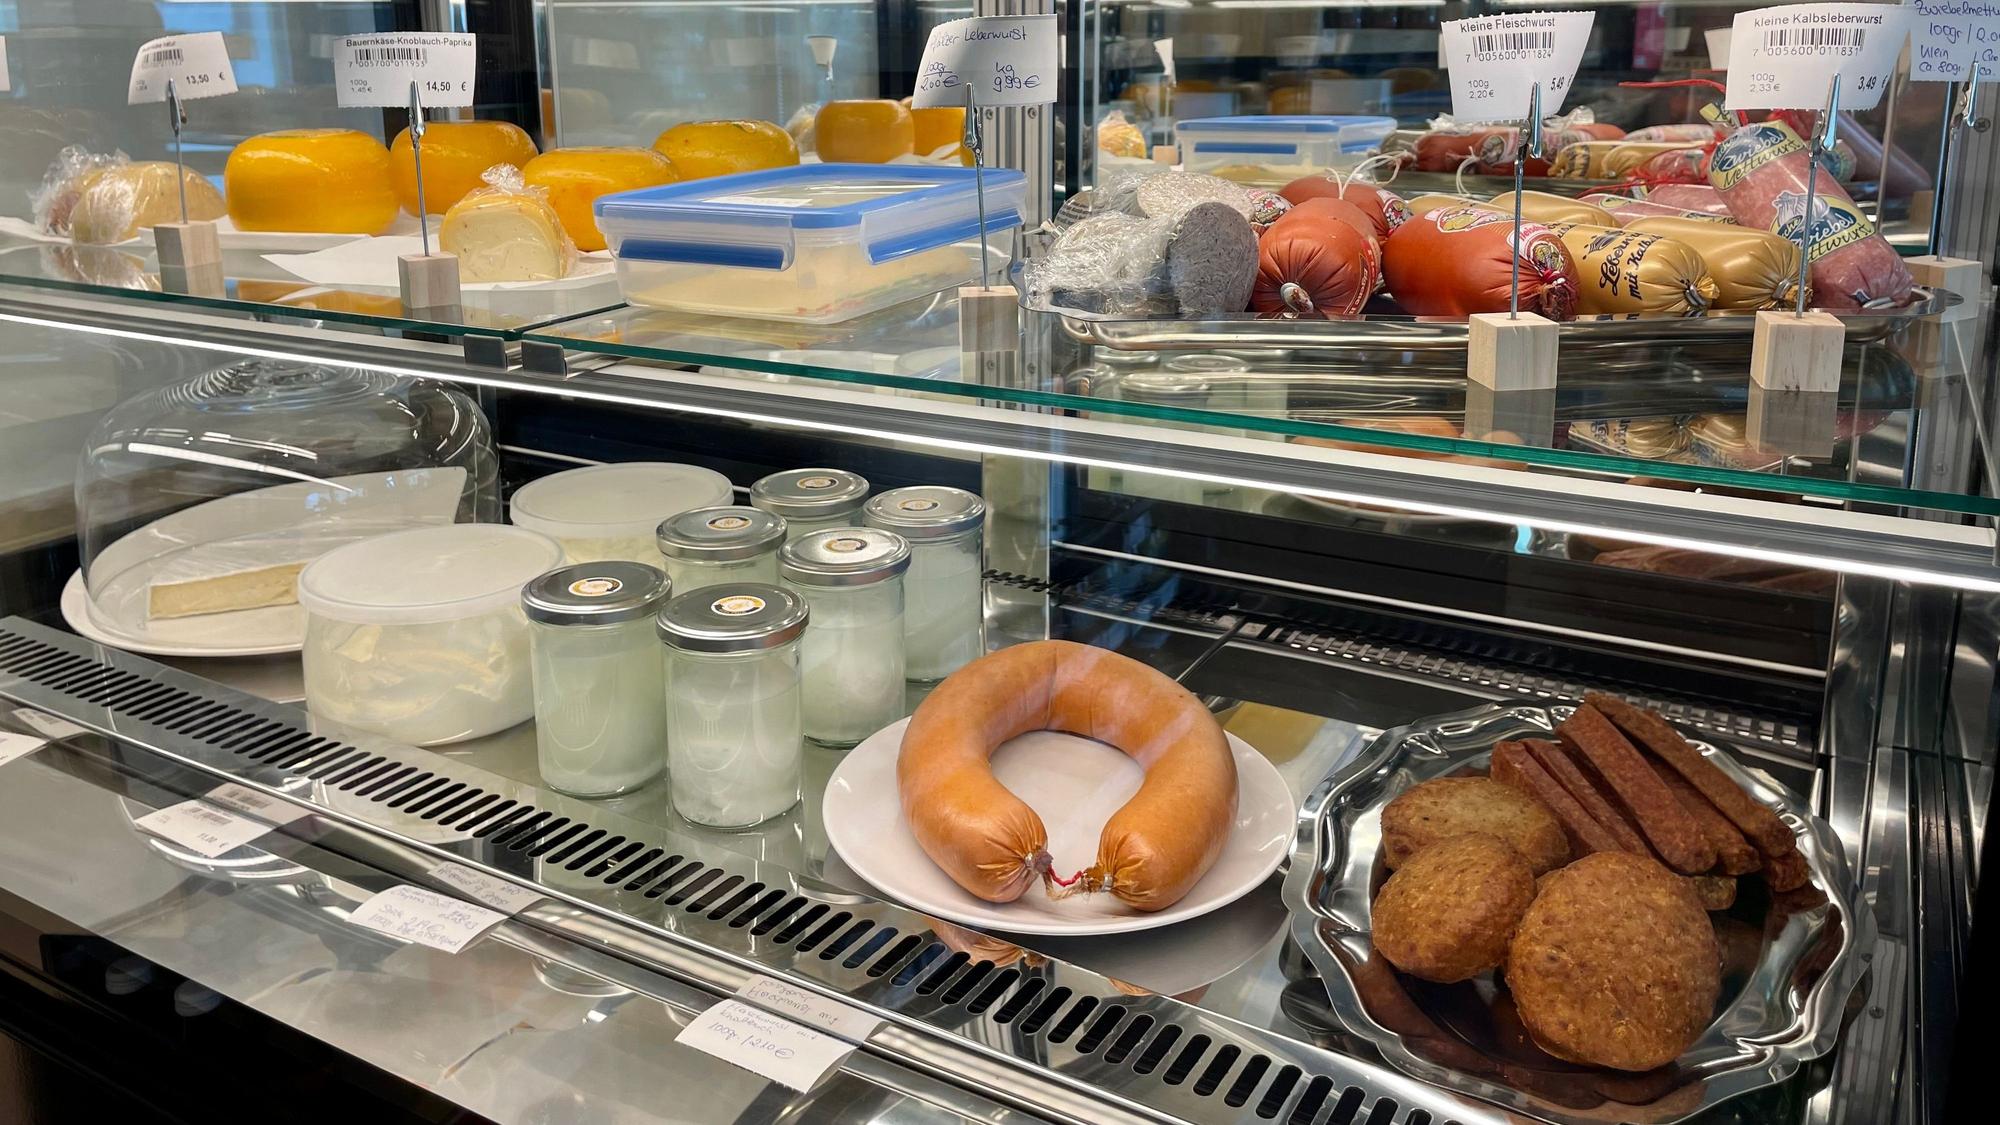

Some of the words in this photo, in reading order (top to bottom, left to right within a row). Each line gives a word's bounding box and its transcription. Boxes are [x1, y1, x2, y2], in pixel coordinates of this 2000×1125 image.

[1460, 21, 1493, 33] kleine
[1495, 17, 1556, 30] Fleischwurst
[1754, 17, 1789, 28] kleine
[1792, 13, 1883, 25] Kalbsleberwurst
[964, 25, 1028, 42] Leberwurst
[346, 36, 472, 47] Bauernkäse-Knoblauch-Paprika
[1466, 54, 1471, 63] 7
[1478, 51, 1517, 62] 005600
[1521, 49, 1552, 60] 011824
[1753, 48, 1758, 57] 7
[1767, 47, 1813, 56] 005600
[1819, 47, 1859, 57] 011831
[995, 62, 1015, 79] kg
[186, 74, 210, 85] 13,50
[219, 71, 225, 80] €
[1467, 80, 1489, 89] 100g
[1751, 73, 1775, 83] 100g
[1858, 76, 1876, 91] 3,49
[426, 81, 451, 93] 14,50
[461, 81, 467, 91] €
